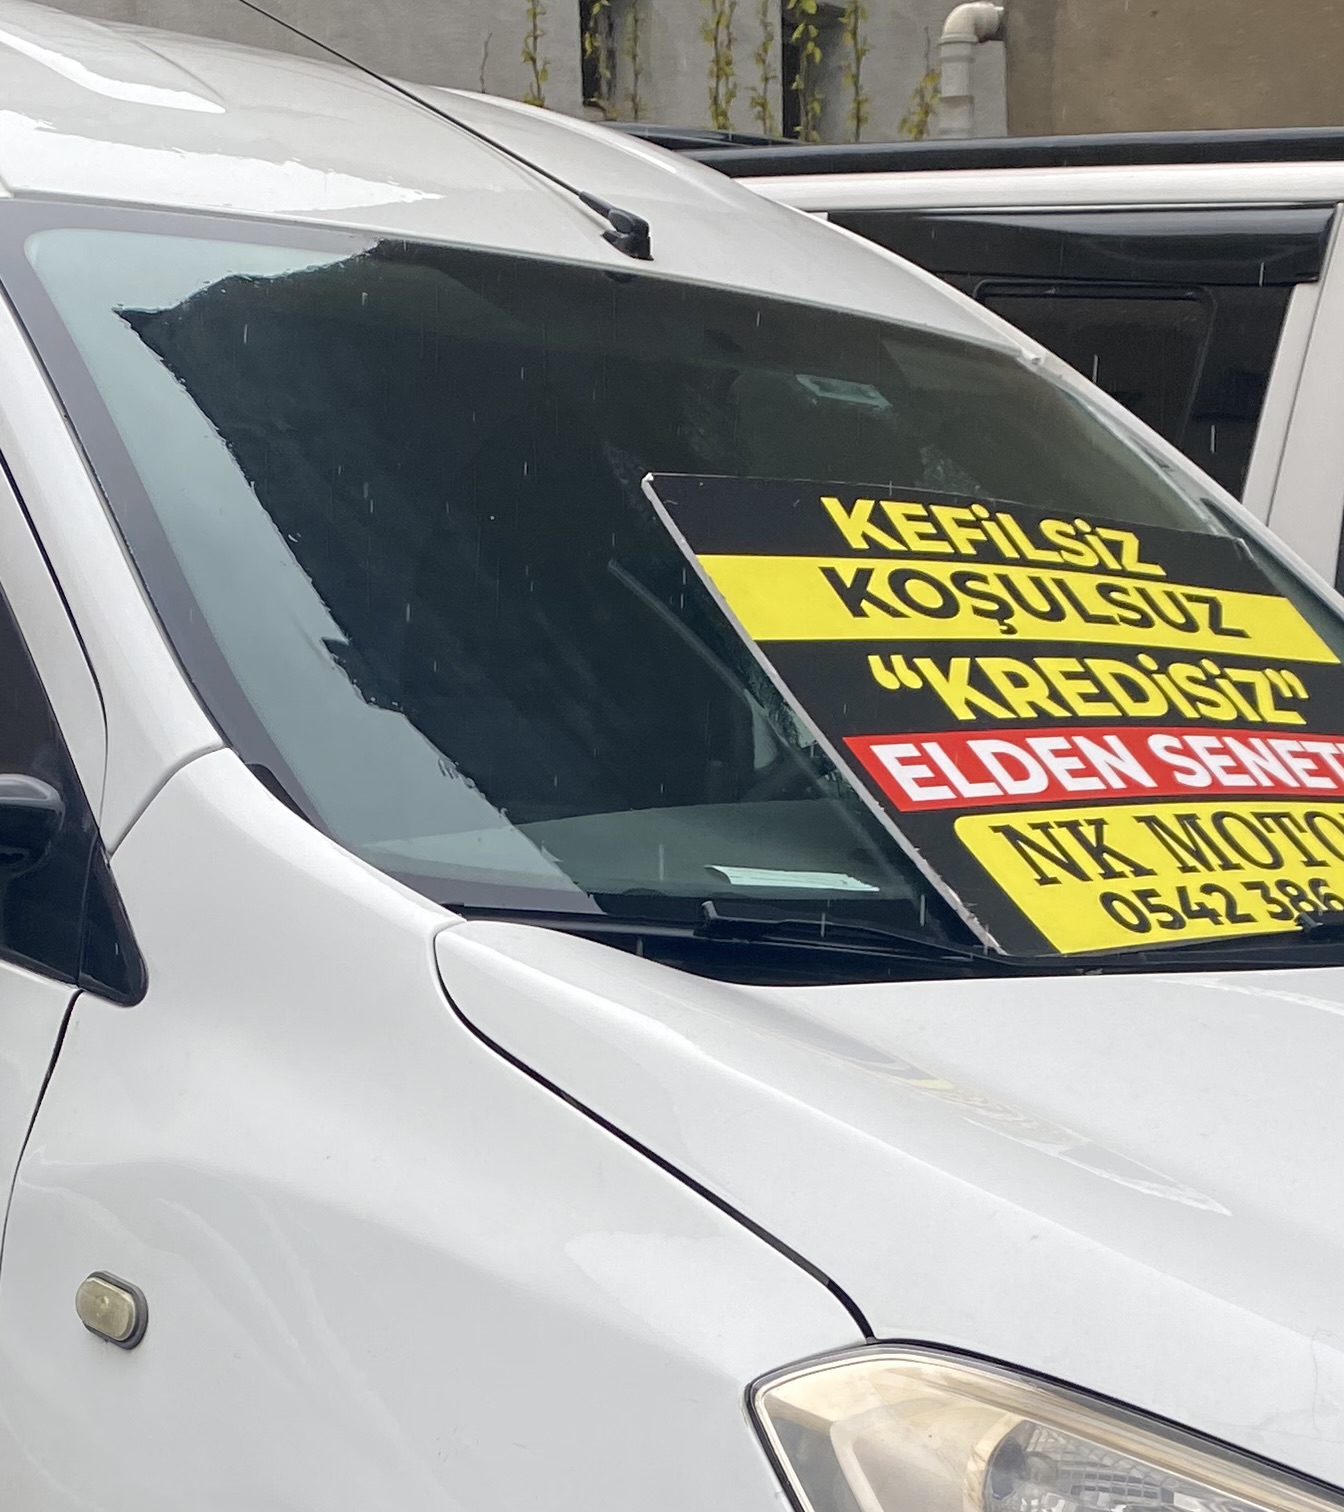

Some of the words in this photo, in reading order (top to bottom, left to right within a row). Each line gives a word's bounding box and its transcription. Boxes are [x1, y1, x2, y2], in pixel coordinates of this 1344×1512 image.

[818, 566, 1253, 639] KOŞULSUZ
[869, 736, 1159, 802] ELDEN
[992, 817, 1156, 887] NK
[1099, 882, 1256, 933] 0542
